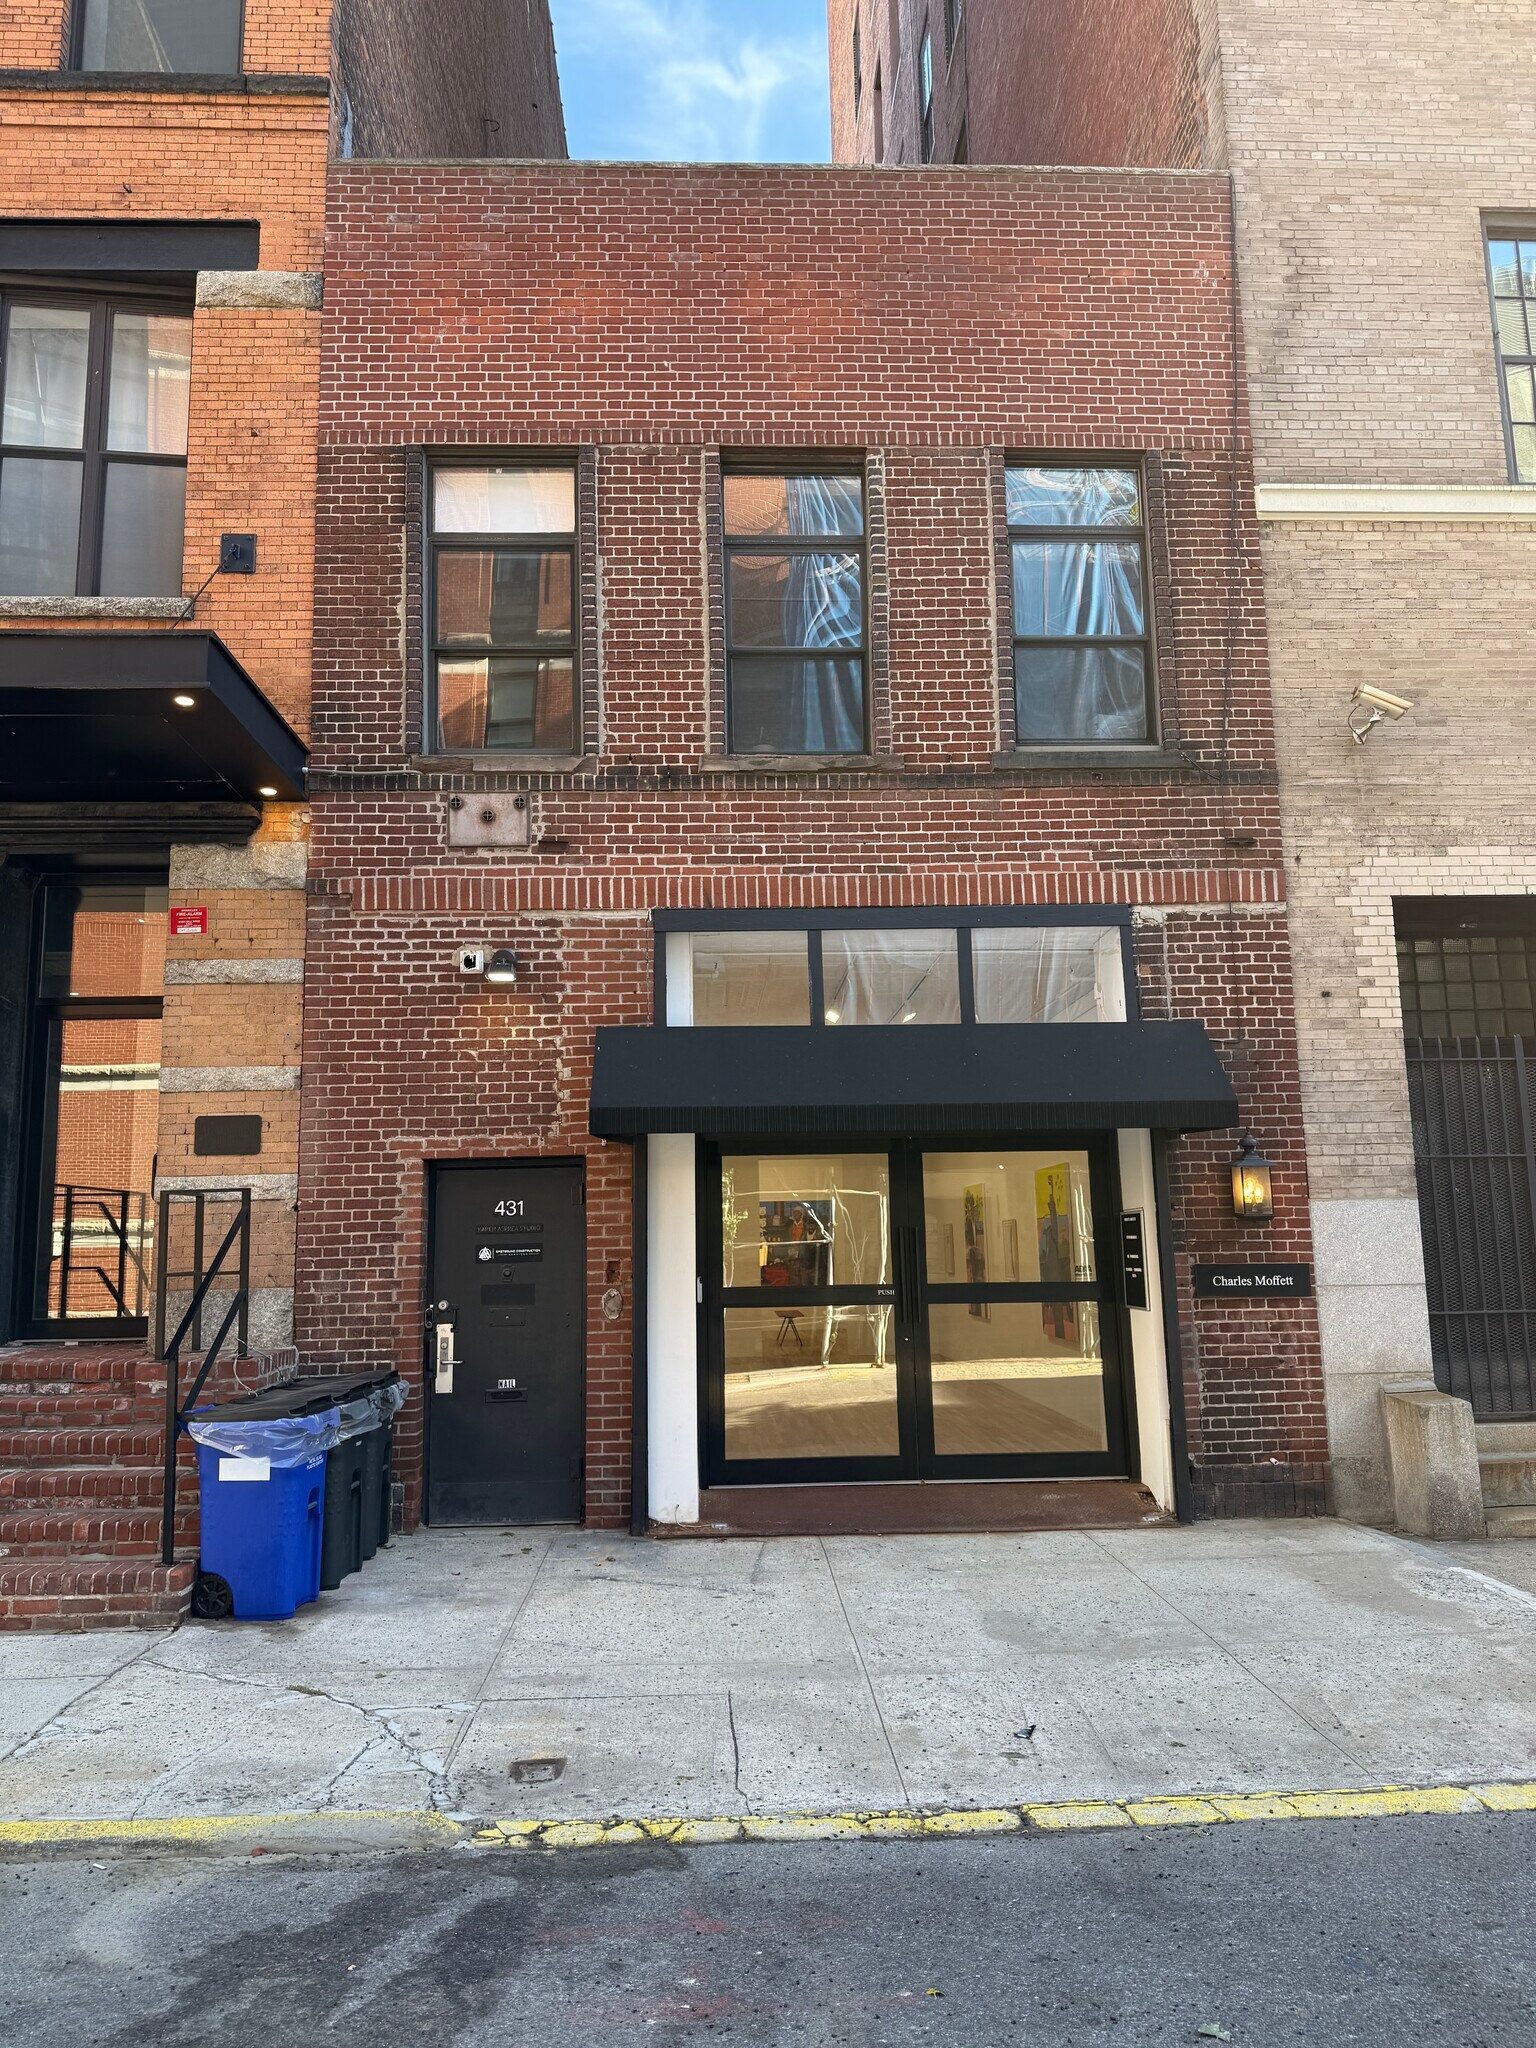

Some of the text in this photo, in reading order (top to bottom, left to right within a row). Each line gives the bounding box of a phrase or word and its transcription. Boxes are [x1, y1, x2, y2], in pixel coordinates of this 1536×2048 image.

[494, 1200, 524, 1216] 431
[1212, 1274, 1294, 1287] Charles Moffett
[498, 1379, 515, 1389] MAIL
